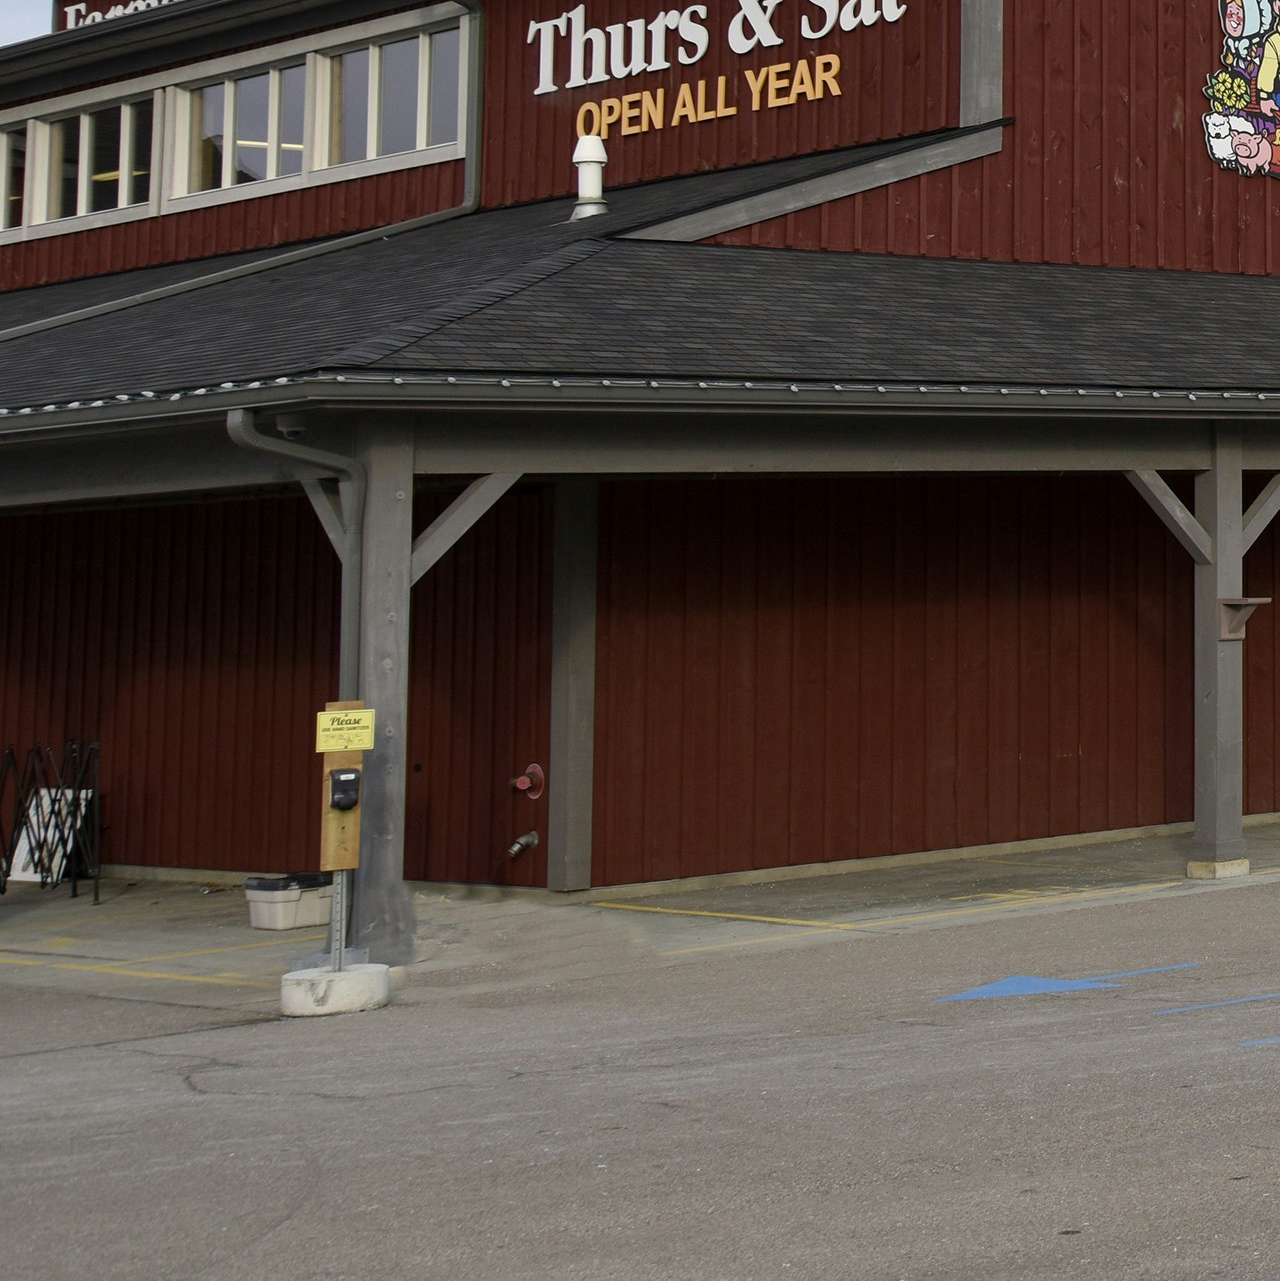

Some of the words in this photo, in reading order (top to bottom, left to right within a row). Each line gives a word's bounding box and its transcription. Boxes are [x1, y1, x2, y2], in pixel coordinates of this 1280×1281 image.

[526, 3, 710, 96] Thurs
[576, 87, 665, 140] OPEN
[671, 74, 737, 127] ALL
[744, 53, 842, 112] YEAR
[330, 716, 362, 726] Please
